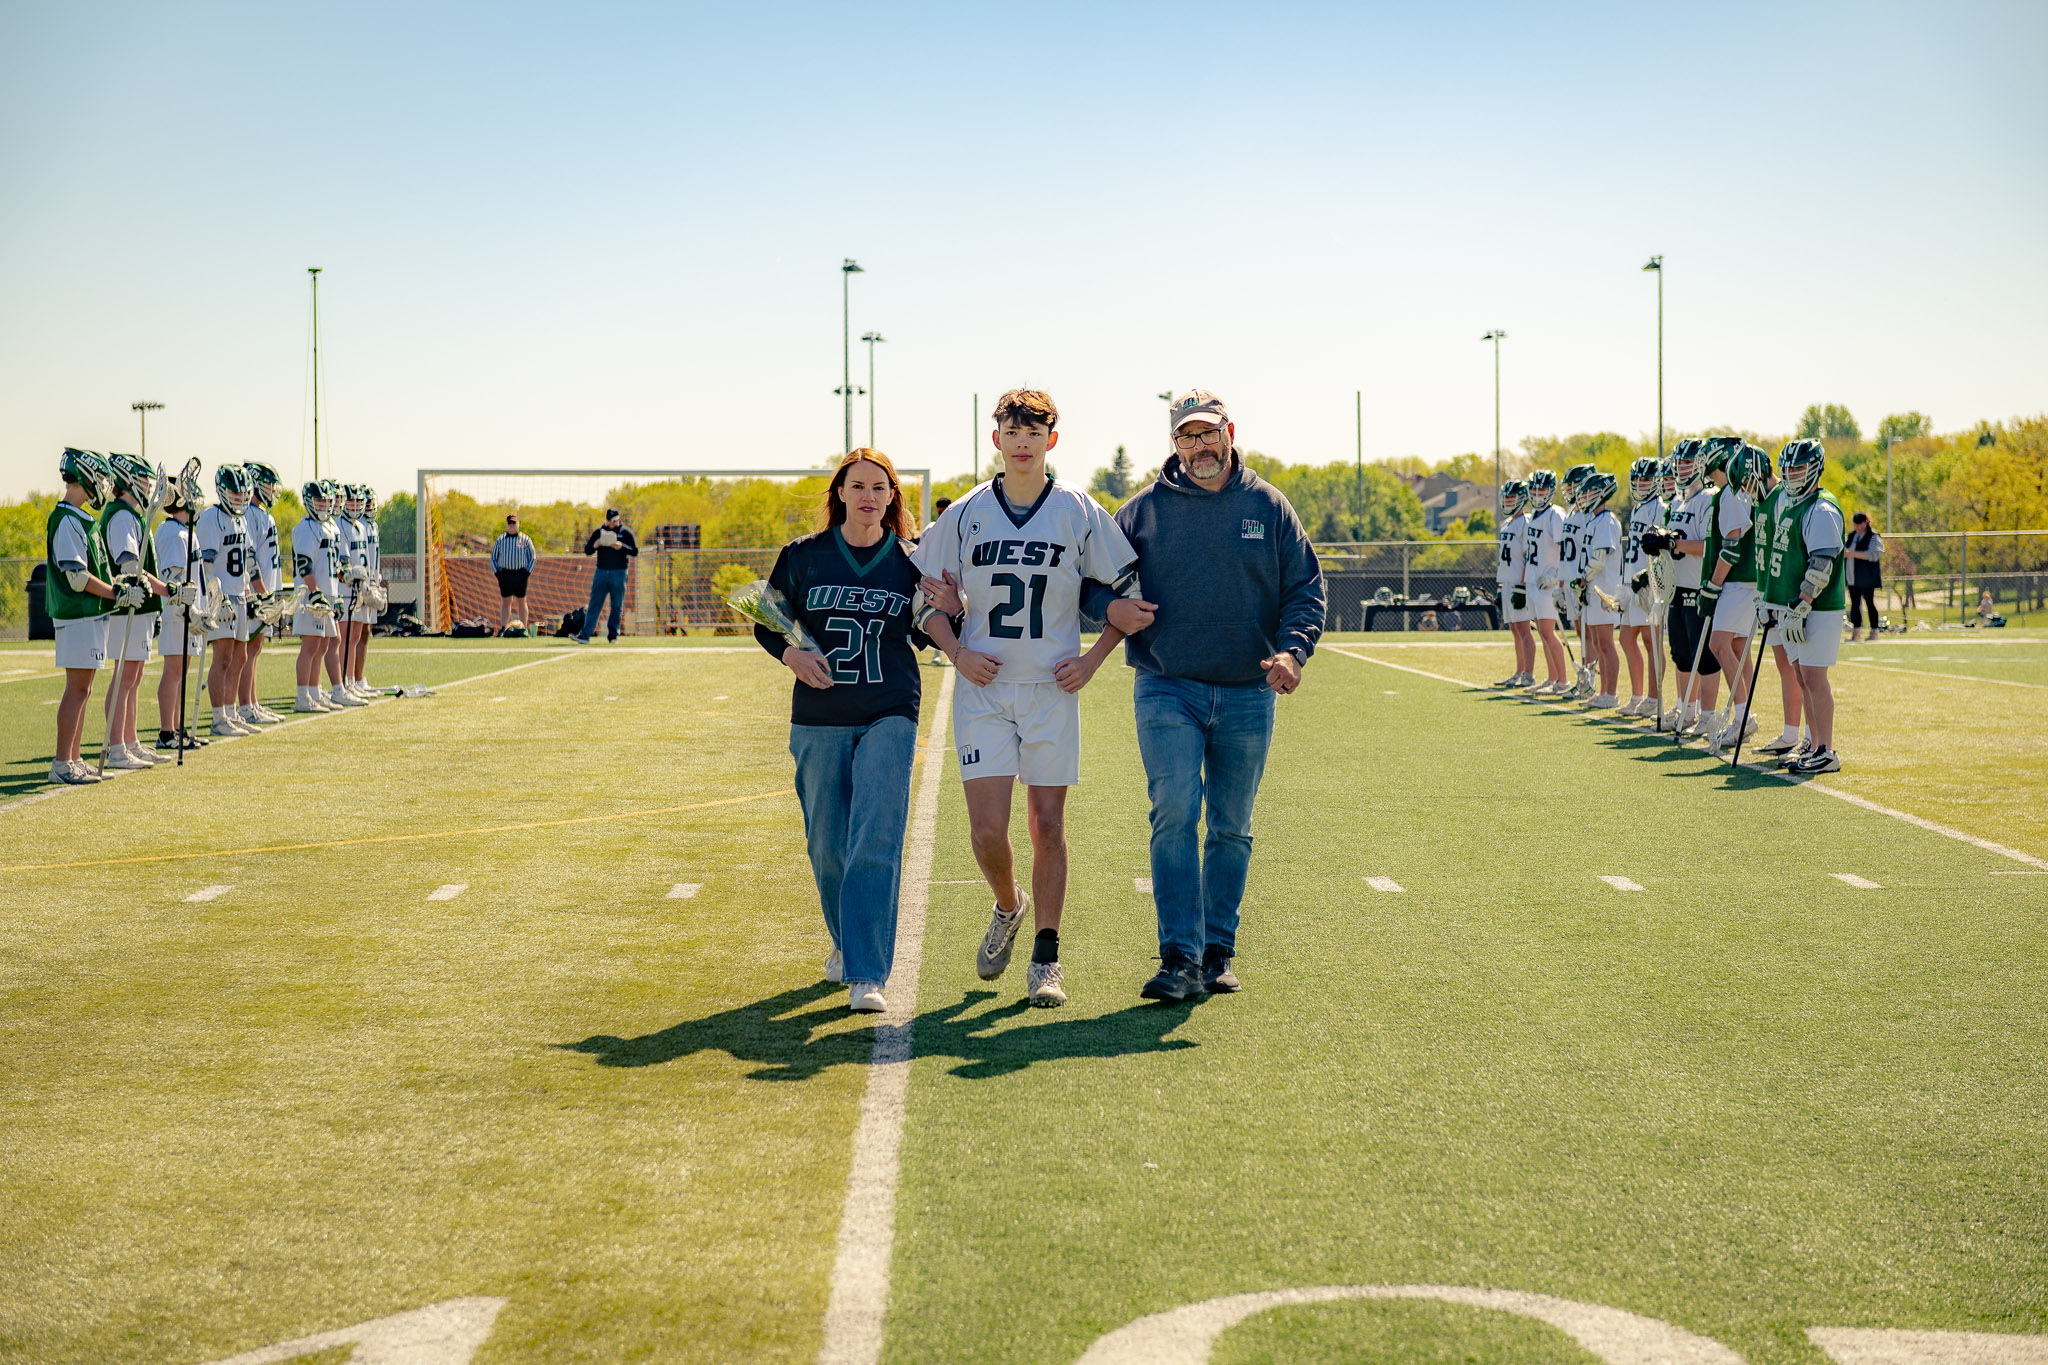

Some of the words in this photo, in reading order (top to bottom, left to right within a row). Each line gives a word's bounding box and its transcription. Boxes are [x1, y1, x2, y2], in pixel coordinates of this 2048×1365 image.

[80, 453, 99, 470] CATS
[115, 455, 133, 472] CATS
[972, 540, 1067, 567] WEST
[1771, 552, 1783, 578] 5
[807, 585, 911, 617] WEST
[988, 573, 1048, 640] 21
[825, 617, 885, 685] 21
